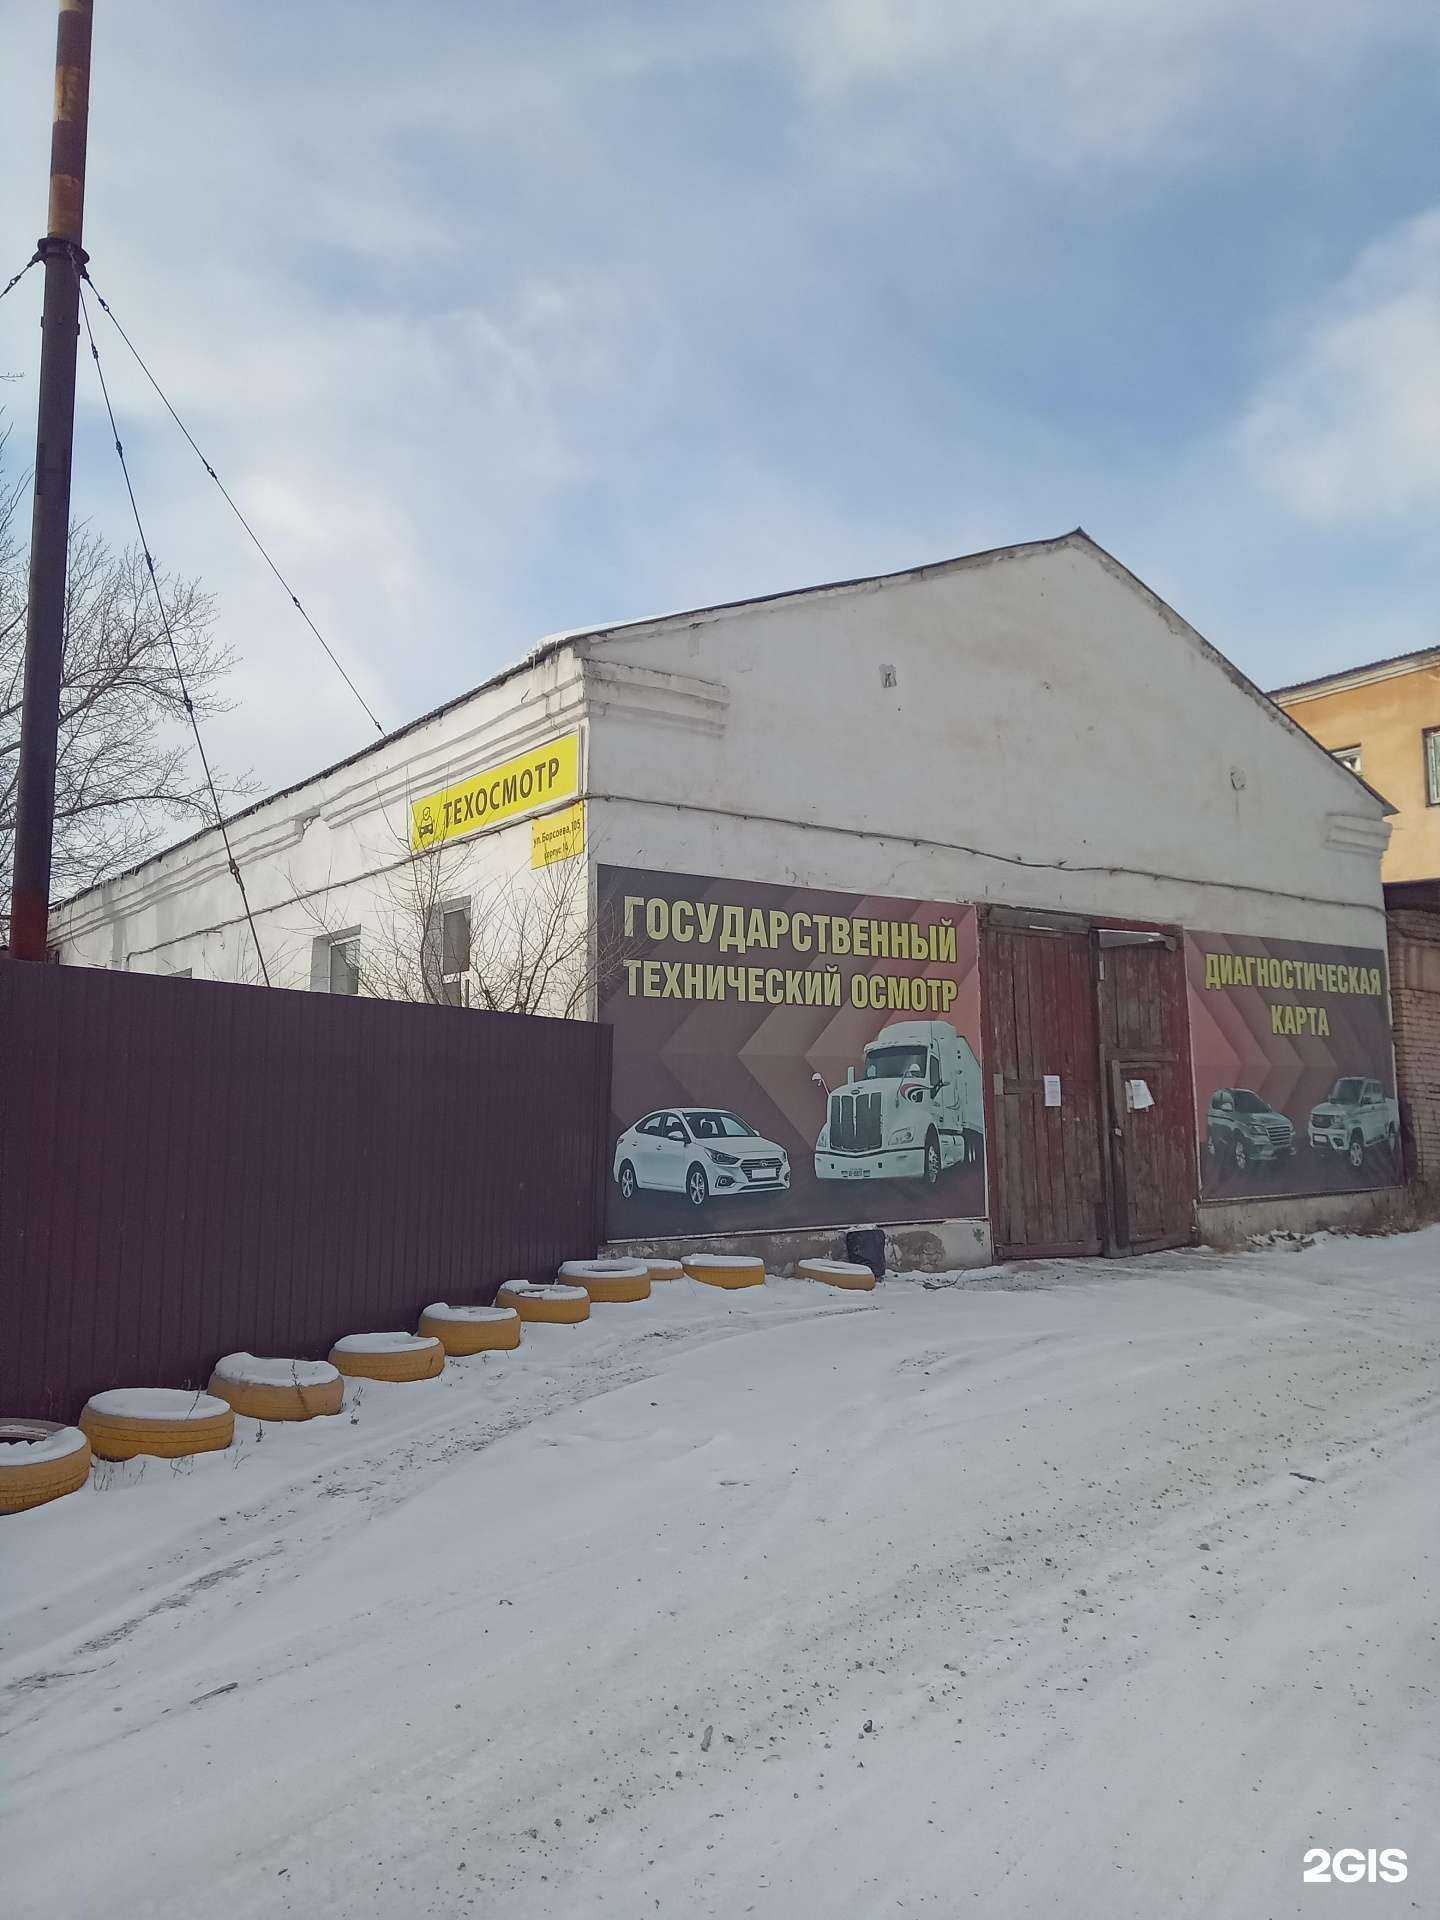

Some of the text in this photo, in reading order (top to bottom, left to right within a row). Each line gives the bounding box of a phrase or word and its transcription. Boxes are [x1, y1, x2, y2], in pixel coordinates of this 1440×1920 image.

[443, 757, 560, 828] ТЕХОСМОТР
[624, 895, 957, 963] ГОСУДАРСТВЕННЫЙ
[623, 959, 958, 1012] ТЕХНИЧЕСКИЙ ОСМОТР
[1205, 953, 1382, 996] ДИАГНОСТИЧЕСКАЯ
[1270, 1004, 1330, 1036] КАРТА
